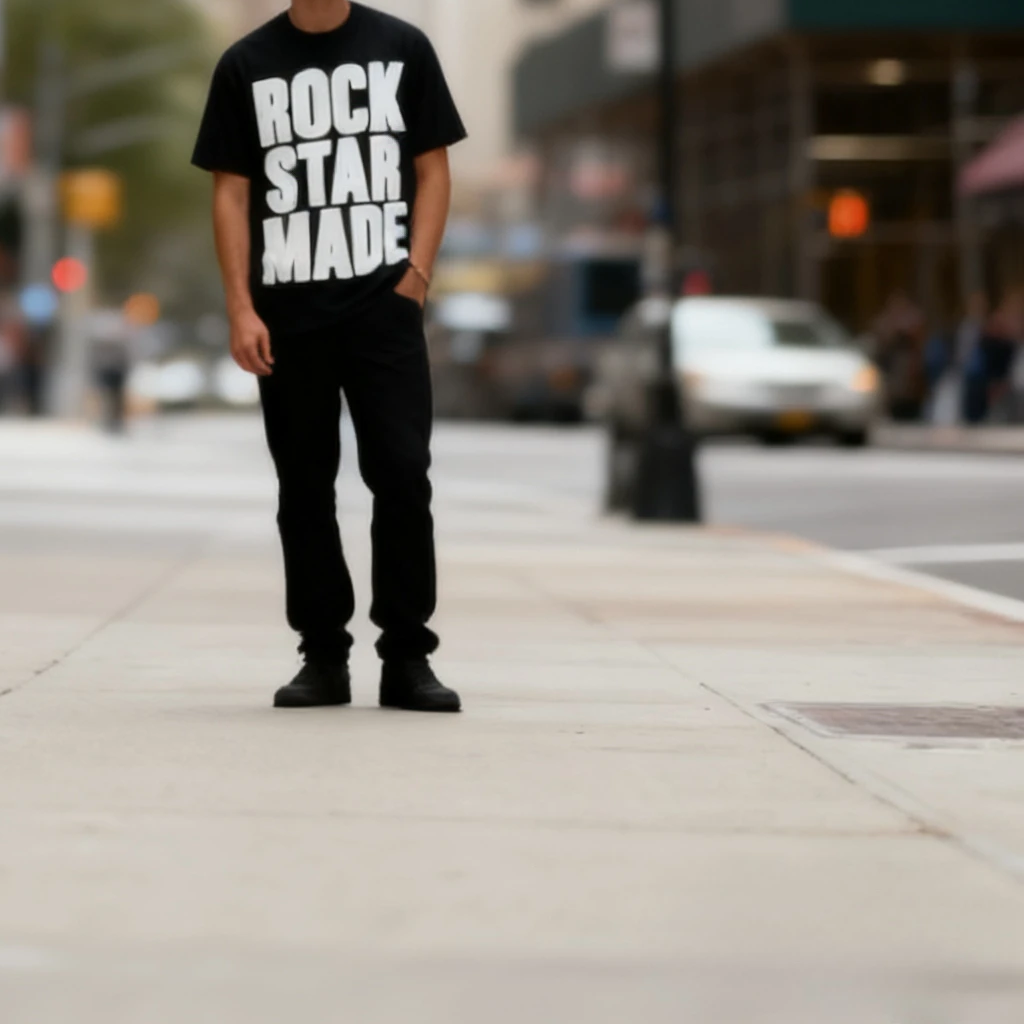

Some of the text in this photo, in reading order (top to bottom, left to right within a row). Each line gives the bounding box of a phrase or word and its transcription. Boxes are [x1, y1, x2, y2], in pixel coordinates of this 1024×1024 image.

[252, 61, 406, 148] ROCK
[264, 134, 401, 214] STAR
[262, 201, 409, 285] MADE
